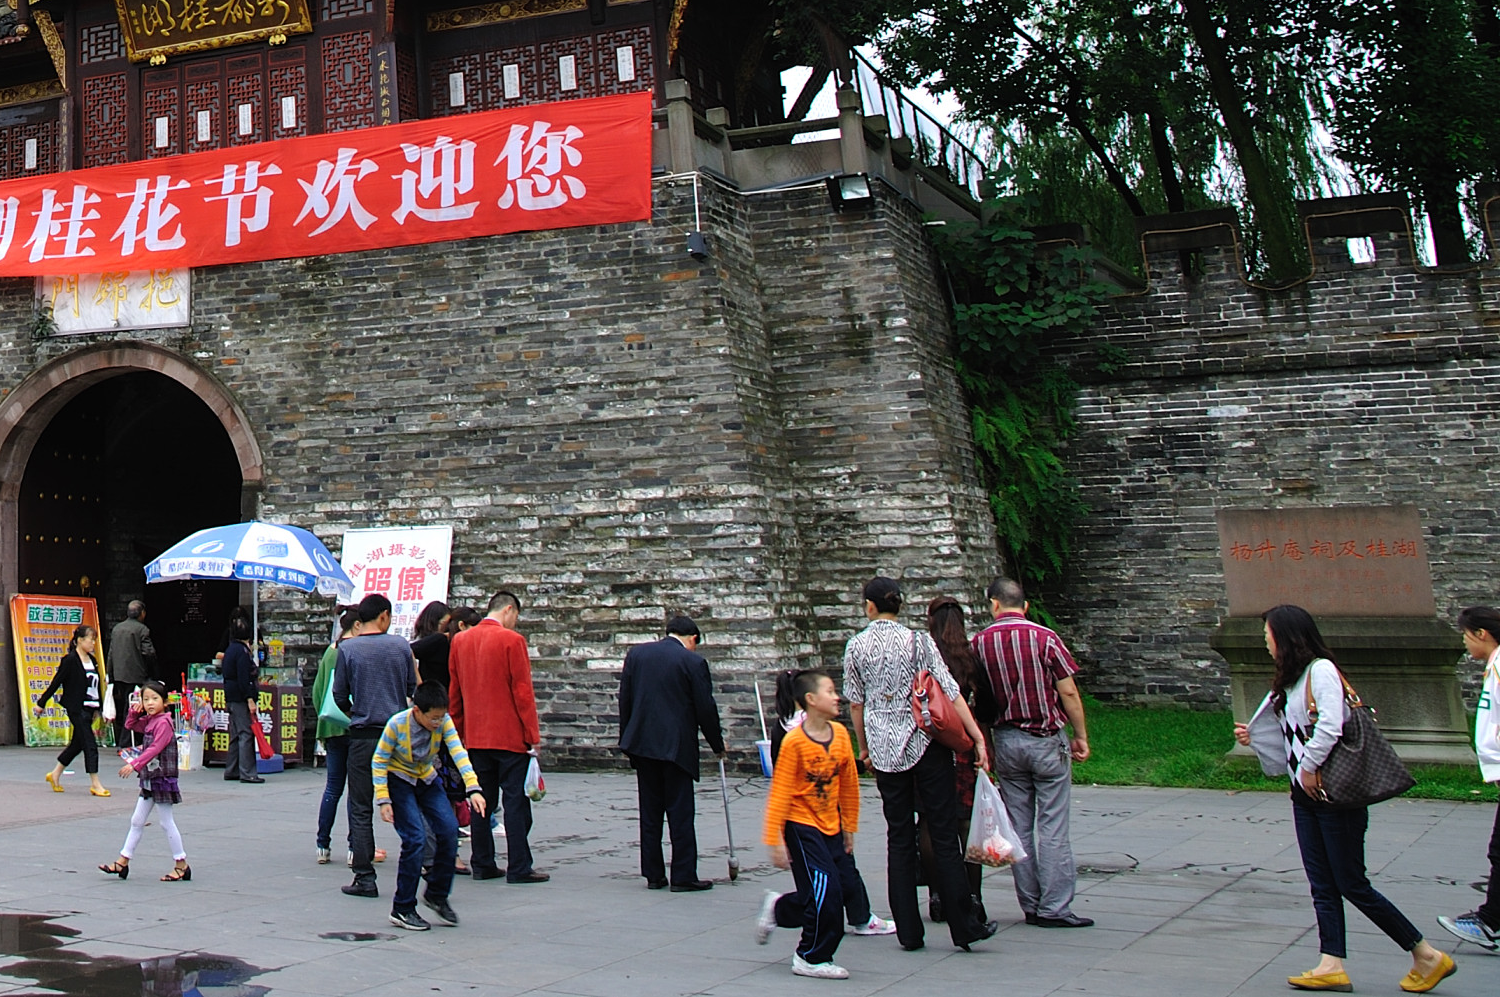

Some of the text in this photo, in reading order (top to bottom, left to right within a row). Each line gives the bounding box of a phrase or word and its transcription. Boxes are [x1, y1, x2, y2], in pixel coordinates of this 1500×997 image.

[349, 543, 442, 579] 桂湖摄影部
[1230, 538, 1418, 562] 杨升庵祠及桂湖
[364, 566, 426, 601] 照像
[28, 606, 82, 623] 敬告游客
[281, 693, 299, 755] 快照快取
